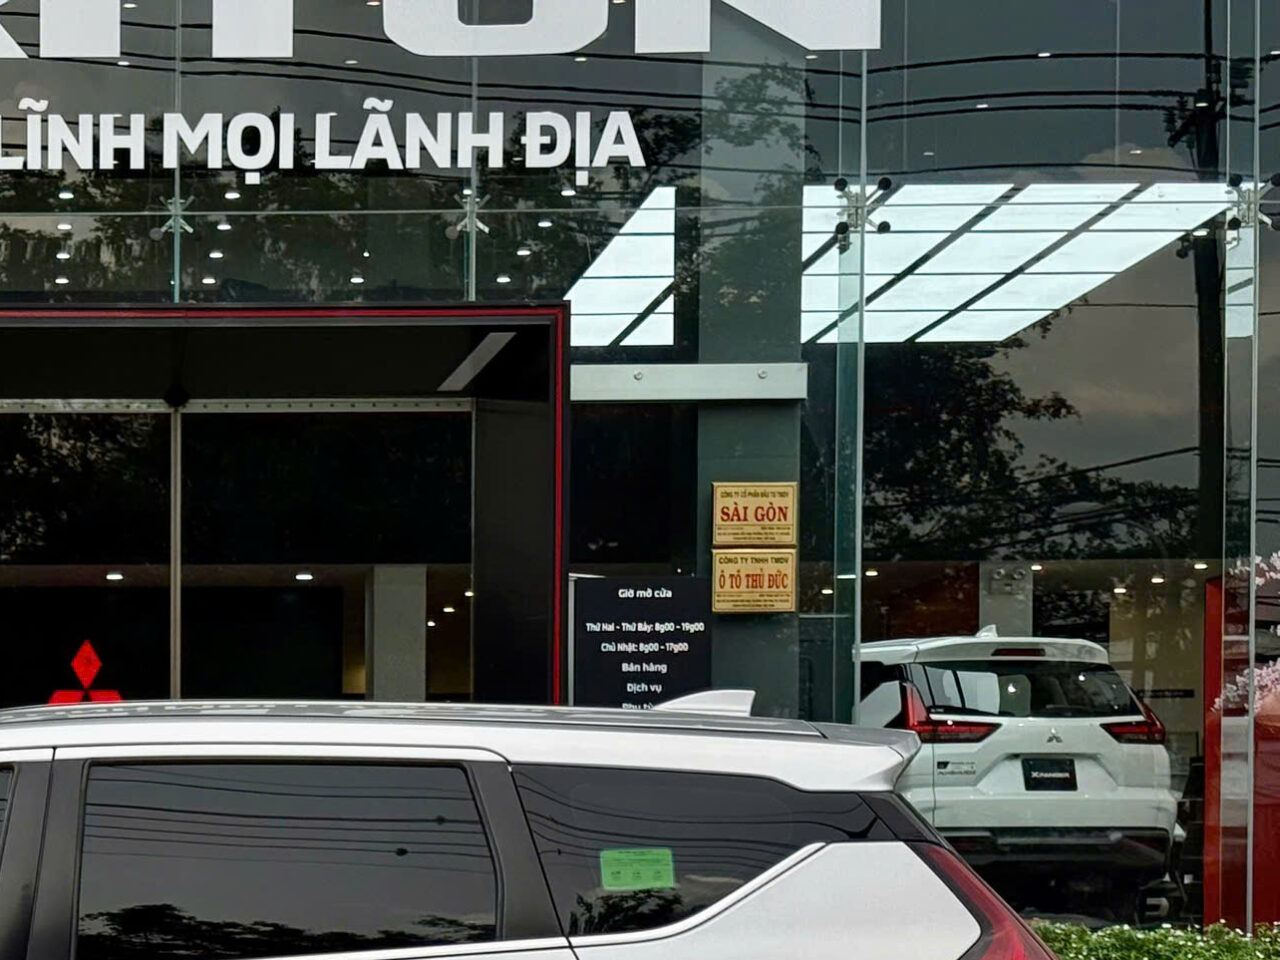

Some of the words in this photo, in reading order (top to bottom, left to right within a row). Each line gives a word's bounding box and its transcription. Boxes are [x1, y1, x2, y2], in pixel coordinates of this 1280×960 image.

[163, 112, 293, 184] MỌI
[315, 97, 503, 170] LÃNH
[521, 111, 646, 184] ĐỊA
[720, 501, 748, 522] SÀI
[754, 501, 788, 522] GÒN
[719, 556, 738, 564] CÔNG
[745, 568, 765, 589] THỦ
[768, 569, 789, 589] ĐỨC
[602, 622, 615, 632] Hai
[655, 622, 675, 633] 8g00
[681, 622, 705, 633] 19g00
[639, 643, 659, 653] 8g00
[665, 643, 689, 653] 17g00
[622, 663, 640, 672] Bán
[642, 663, 667, 674] hàng
[627, 683, 648, 694] Dịch
[650, 684, 662, 693] vụ
